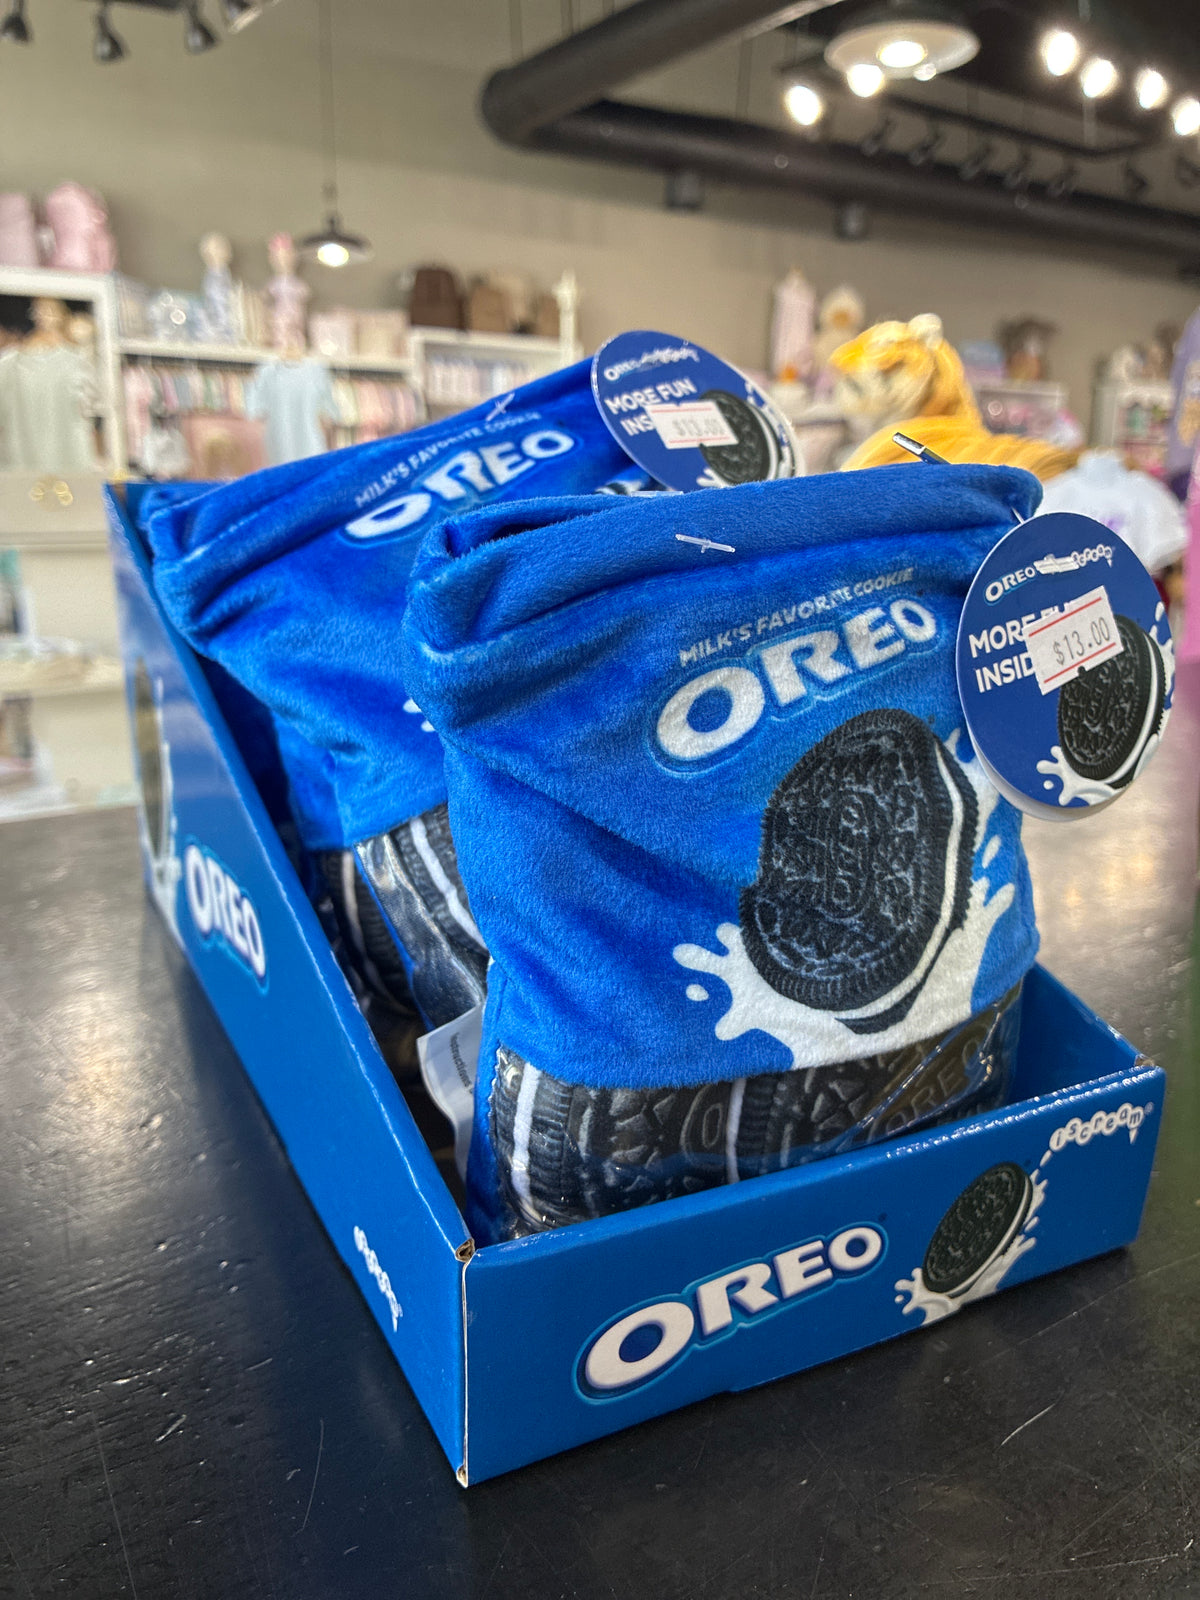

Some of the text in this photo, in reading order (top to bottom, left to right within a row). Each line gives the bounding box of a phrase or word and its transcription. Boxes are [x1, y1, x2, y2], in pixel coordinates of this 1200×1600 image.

[604, 377, 697, 415] MORE FUN
[344, 430, 575, 539] OREO
[355, 462, 411, 508] MILK'S
[985, 566, 1036, 602] OREO
[679, 622, 752, 668] MILK'S
[853, 567, 914, 598] COOKIE
[1053, 616, 1110, 665] $13.00
[657, 599, 936, 761] OREO
[975, 651, 1035, 693] INSID
[185, 844, 265, 977] OREO
[1049, 1103, 1145, 1152] iscream
[585, 1227, 882, 1389] OREO
